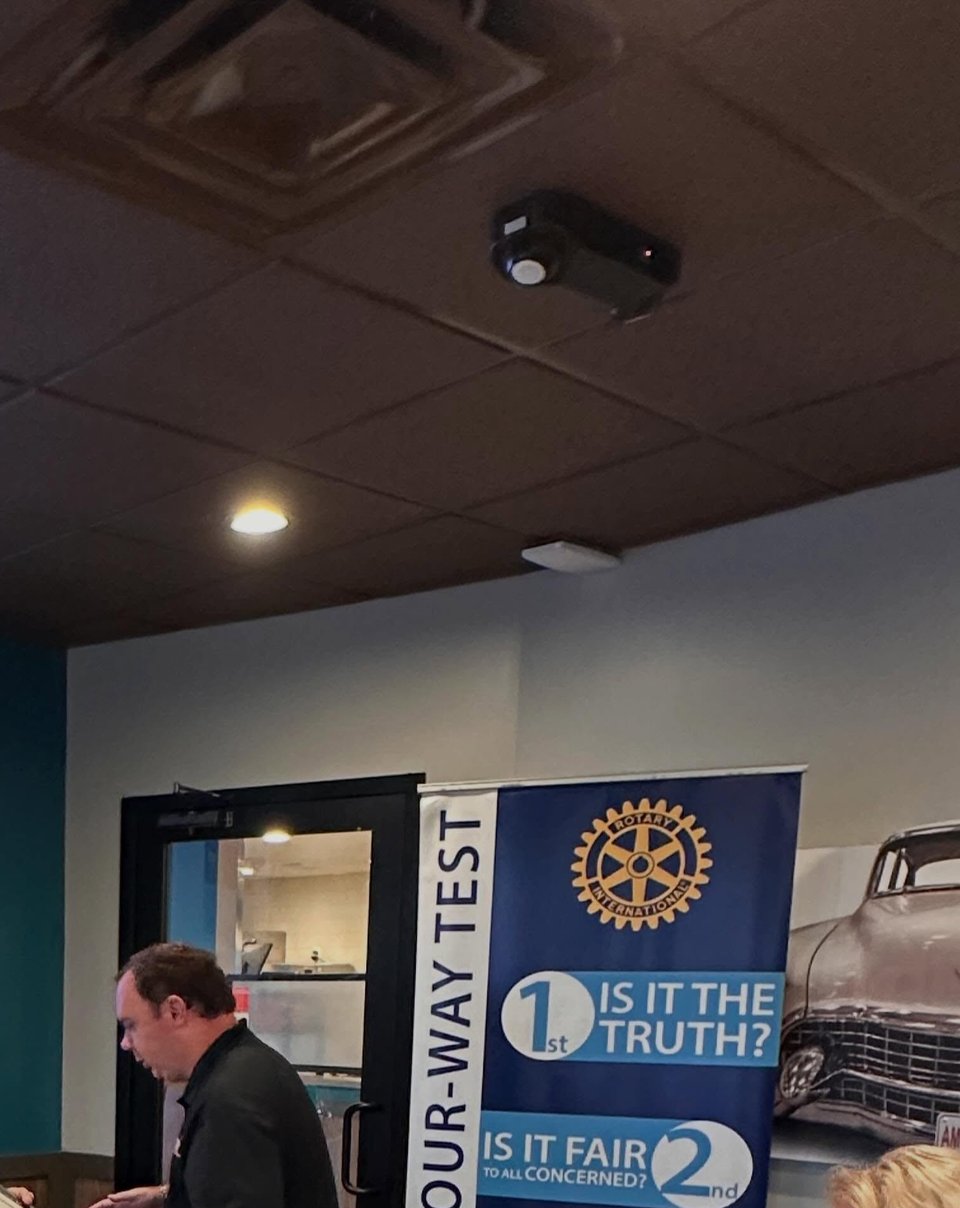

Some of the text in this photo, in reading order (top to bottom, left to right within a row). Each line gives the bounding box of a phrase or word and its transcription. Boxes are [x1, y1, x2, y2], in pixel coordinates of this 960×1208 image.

[614, 813, 673, 831] ROTARY
[435, 809, 482, 944] TEST
[593, 881, 690, 917] INTERNATIONAL
[599, 982, 776, 1017] IS IT THE
[598, 1020, 772, 1058] TRUTH?
[483, 1131, 647, 1170] IS IT FAIR
[660, 1128, 738, 1199] 2nd
[484, 1167, 647, 1189] TO ALL CONCERNED?
